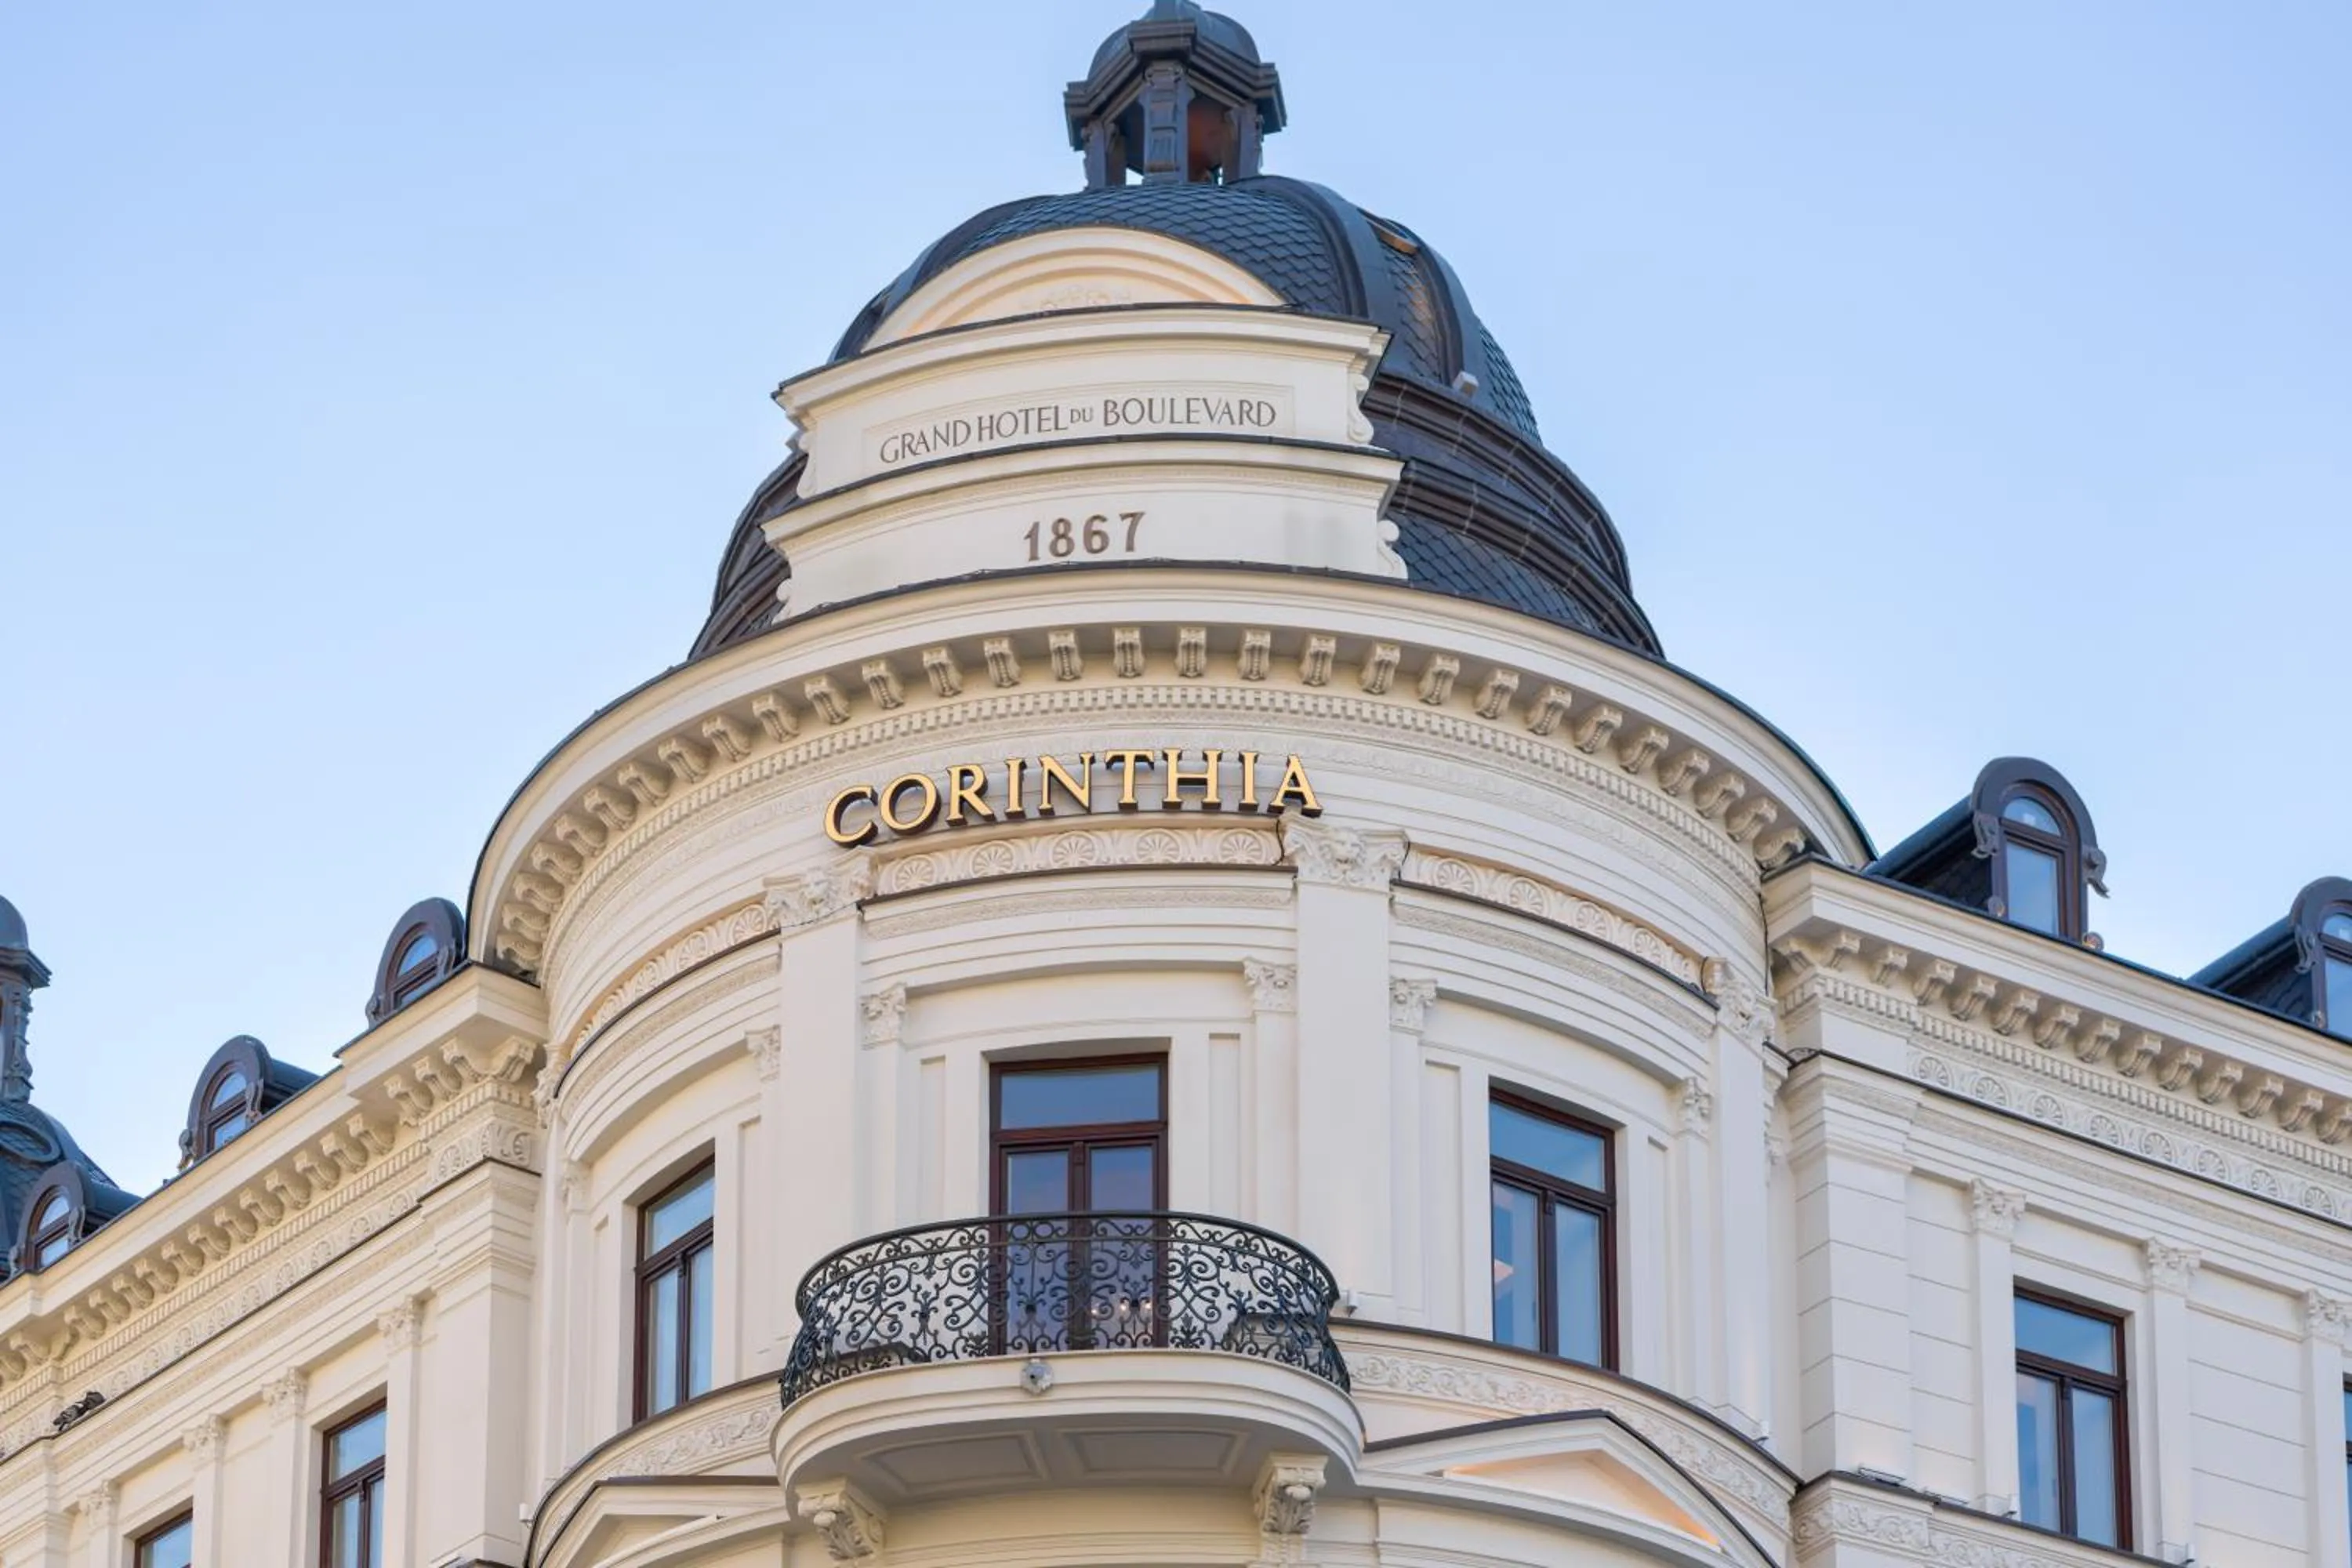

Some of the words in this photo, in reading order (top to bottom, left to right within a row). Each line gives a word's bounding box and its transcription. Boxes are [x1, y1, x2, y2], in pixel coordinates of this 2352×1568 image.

[880, 419, 971, 463] GRAND
[978, 405, 1068, 442] HOTEL
[1069, 407, 1094, 423] DU
[1102, 397, 1277, 428] BOULEVARD
[1023, 511, 1146, 561] 1867
[823, 747, 1323, 848] CORINTHIA
